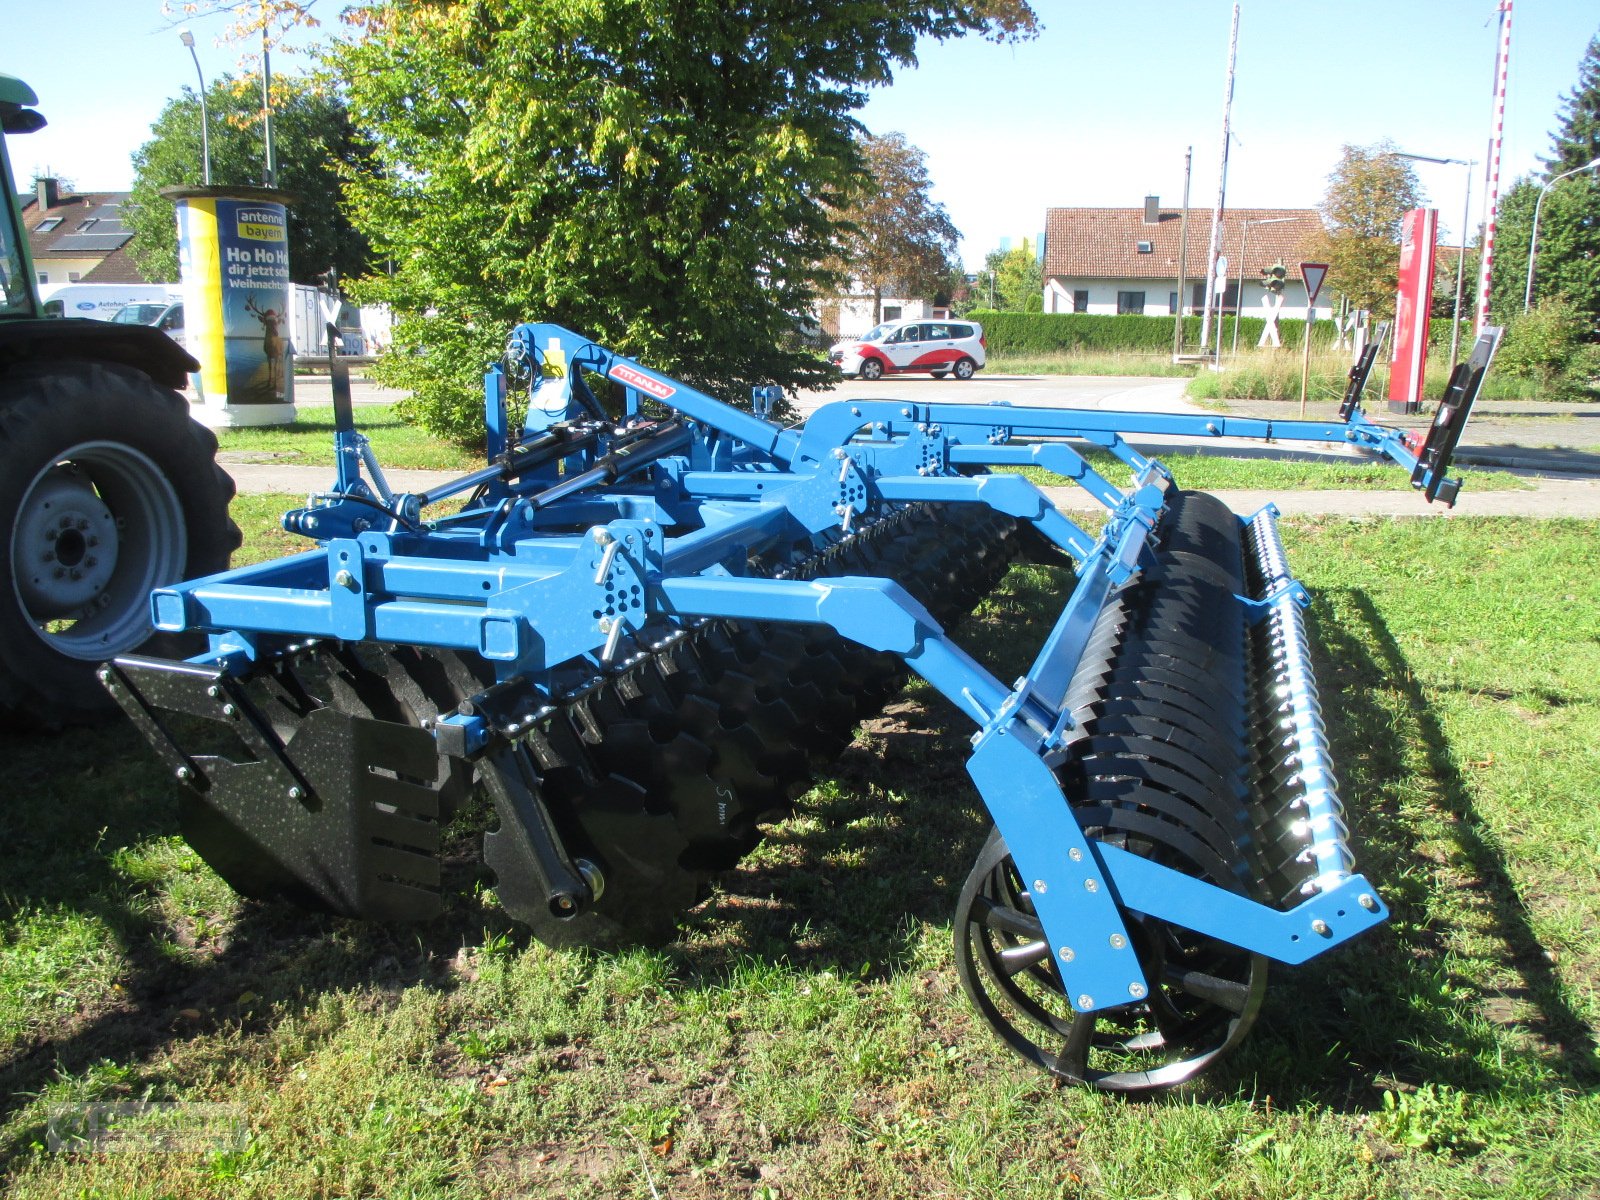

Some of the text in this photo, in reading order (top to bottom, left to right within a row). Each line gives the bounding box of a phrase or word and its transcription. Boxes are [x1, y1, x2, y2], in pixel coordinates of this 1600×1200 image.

[241, 212, 283, 225] antenne
[246, 225, 282, 240] bayern
[226, 247, 252, 262] Ho
[254, 248, 275, 263] Ho
[228, 264, 246, 275] dir
[246, 264, 274, 278] jetzt
